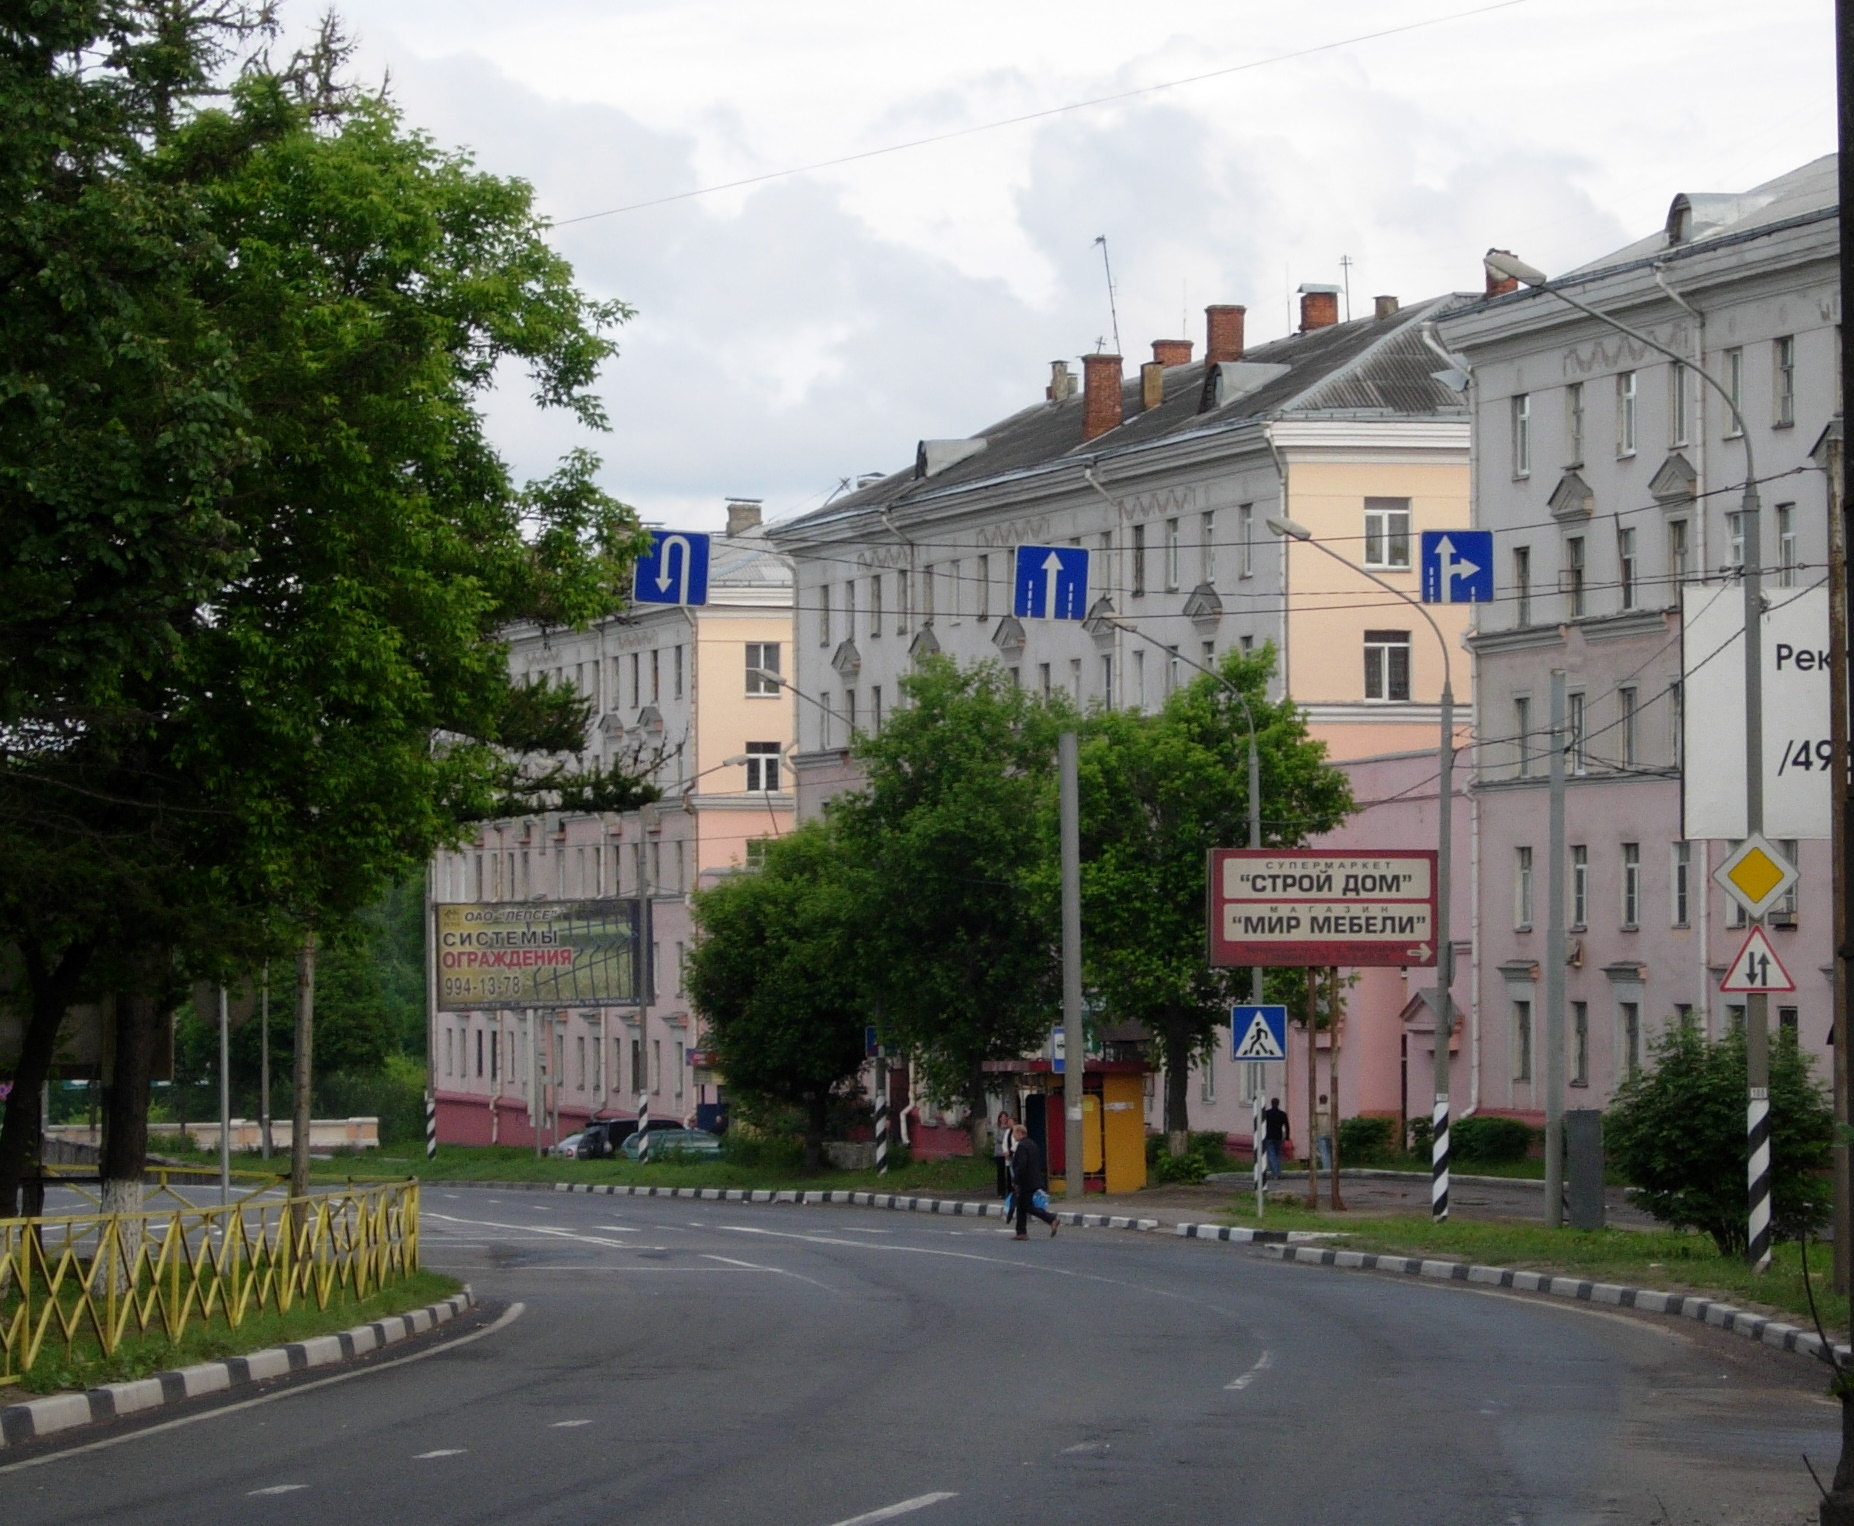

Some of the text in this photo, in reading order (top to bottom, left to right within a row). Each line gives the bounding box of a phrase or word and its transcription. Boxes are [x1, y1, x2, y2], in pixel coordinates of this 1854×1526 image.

[1776, 643, 1832, 671] Рек
[1777, 739, 1832, 777] /49
[1265, 861, 1392, 870] СУПЕРМАРКЕТ
[464, 911, 494, 922] ОАО
[1270, 905, 1389, 914] МАГАЗИН
[442, 930, 558, 947] СИСТЕМЫ
[442, 948, 572, 969] ОГРАЖДЕНИЯ
[444, 976, 521, 996] 994-13-78
